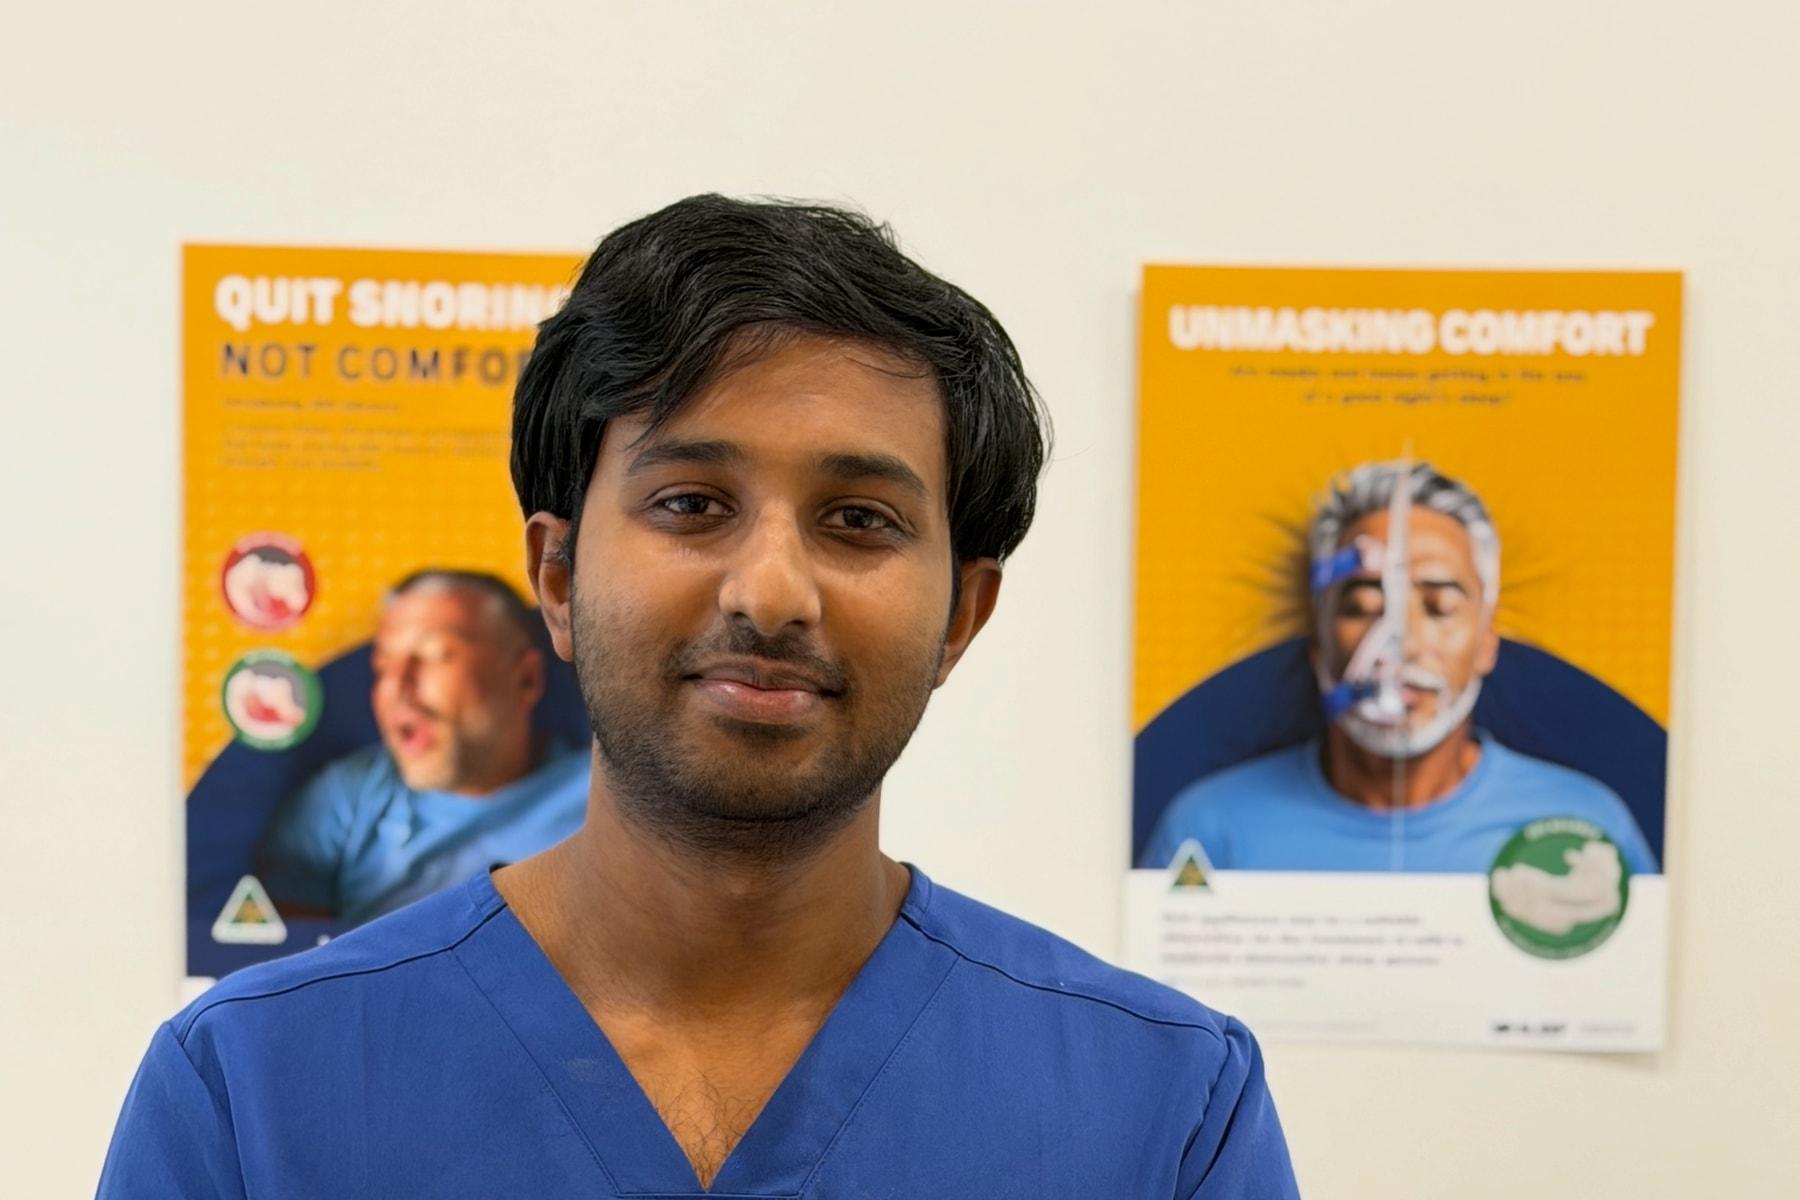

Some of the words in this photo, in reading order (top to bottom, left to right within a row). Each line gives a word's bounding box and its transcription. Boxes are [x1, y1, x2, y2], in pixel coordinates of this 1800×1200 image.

[215, 276, 340, 331] QUIT
[1169, 306, 1436, 353] UNMASKING
[1440, 308, 1653, 355] COMFORT
[222, 342, 317, 379] NOT
[338, 346, 532, 386] COMFO
